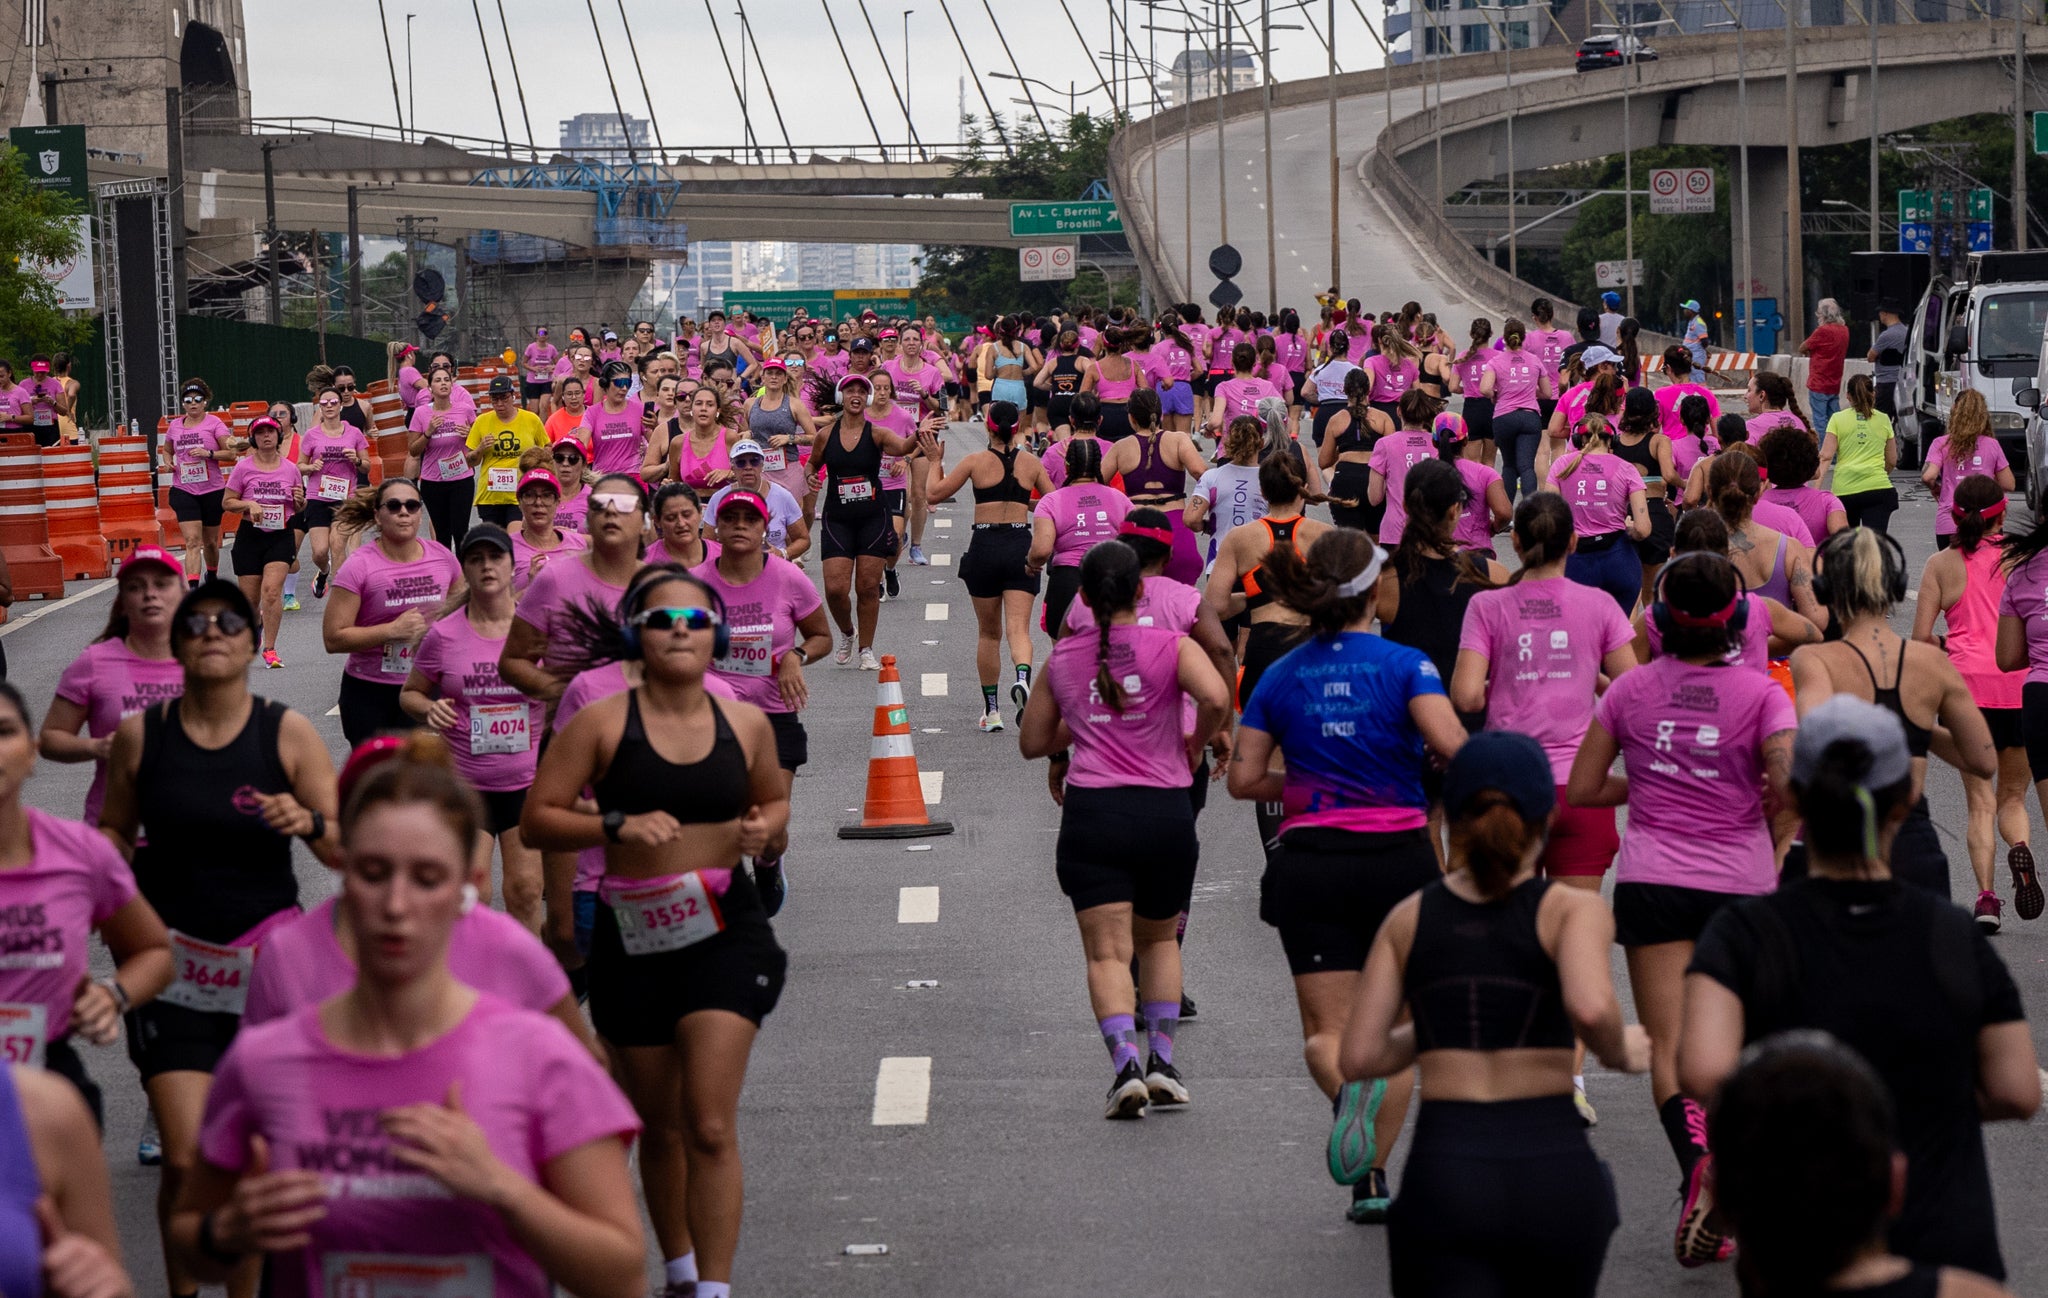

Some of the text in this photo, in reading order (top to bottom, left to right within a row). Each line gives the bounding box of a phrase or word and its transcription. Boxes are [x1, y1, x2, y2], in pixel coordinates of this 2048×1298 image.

[1659, 177, 1673, 187] 60
[1691, 176, 1705, 187] 50
[1018, 207, 1101, 218] Av. L. C. Berrini
[1056, 220, 1102, 229] Brooklin
[765, 454, 781, 463] 4241
[448, 459, 464, 470] 4104
[188, 467, 204, 475] 4633
[528, 471, 550, 479] Jeep
[497, 475, 514, 483] 2813
[328, 484, 346, 493] 2852
[851, 484, 866, 494] 435
[1232, 479, 1249, 527] OTION
[264, 512, 282, 520] 2757
[394, 575, 434, 588] VENUS
[385, 584, 442, 600] WOMEN'S
[385, 594, 441, 607] HALF MARATHON
[730, 623, 774, 634] MARATHON
[731, 647, 767, 661] 3700
[472, 662, 500, 674] VEN
[1515, 671, 1539, 680] Jeep
[1547, 671, 1572, 679] cosan
[462, 688, 484, 696] HALF
[1087, 713, 1111, 723] Jeep
[489, 718, 525, 736] 4074
[1649, 759, 1679, 774] Jeep
[0, 904, 46, 926] NUS
[641, 897, 700, 929] 3552
[183, 960, 240, 988] 3644
